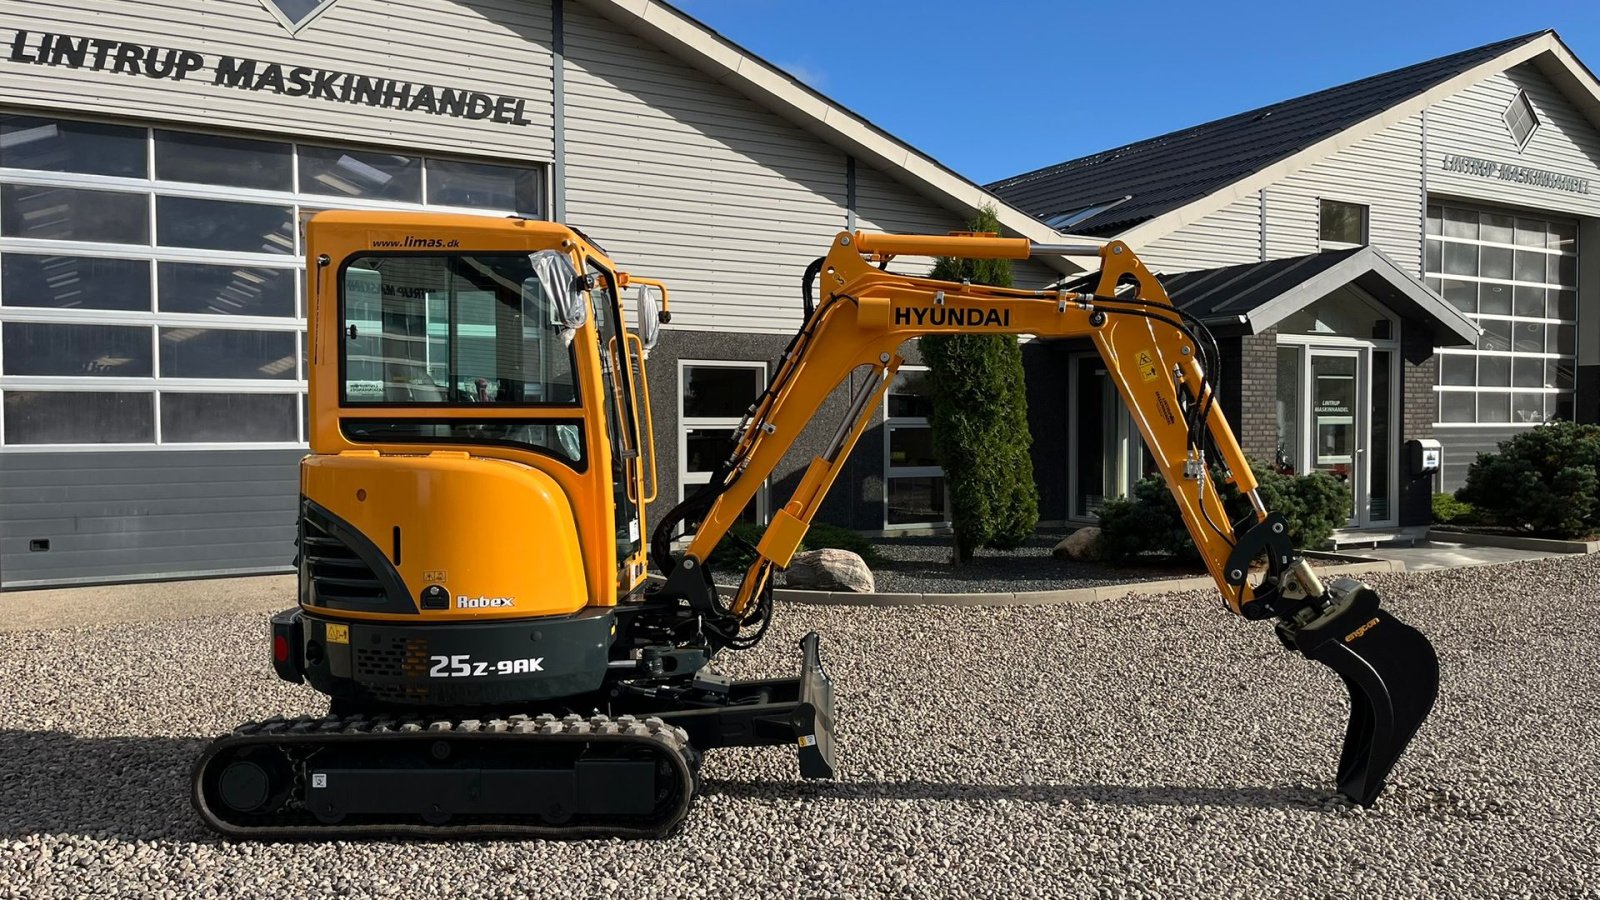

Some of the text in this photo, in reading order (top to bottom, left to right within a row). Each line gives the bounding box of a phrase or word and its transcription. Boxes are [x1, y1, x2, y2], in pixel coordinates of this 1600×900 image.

[8, 29, 532, 127] LINTRUP MASKINHANDEL
[1442, 154, 1591, 195] LINTRUP MASKINHANDEL
[372, 235, 461, 248] www.limas.dk
[895, 306, 1010, 327] HYUNDAI
[456, 595, 515, 609] Robex
[1345, 617, 1380, 642] engcon
